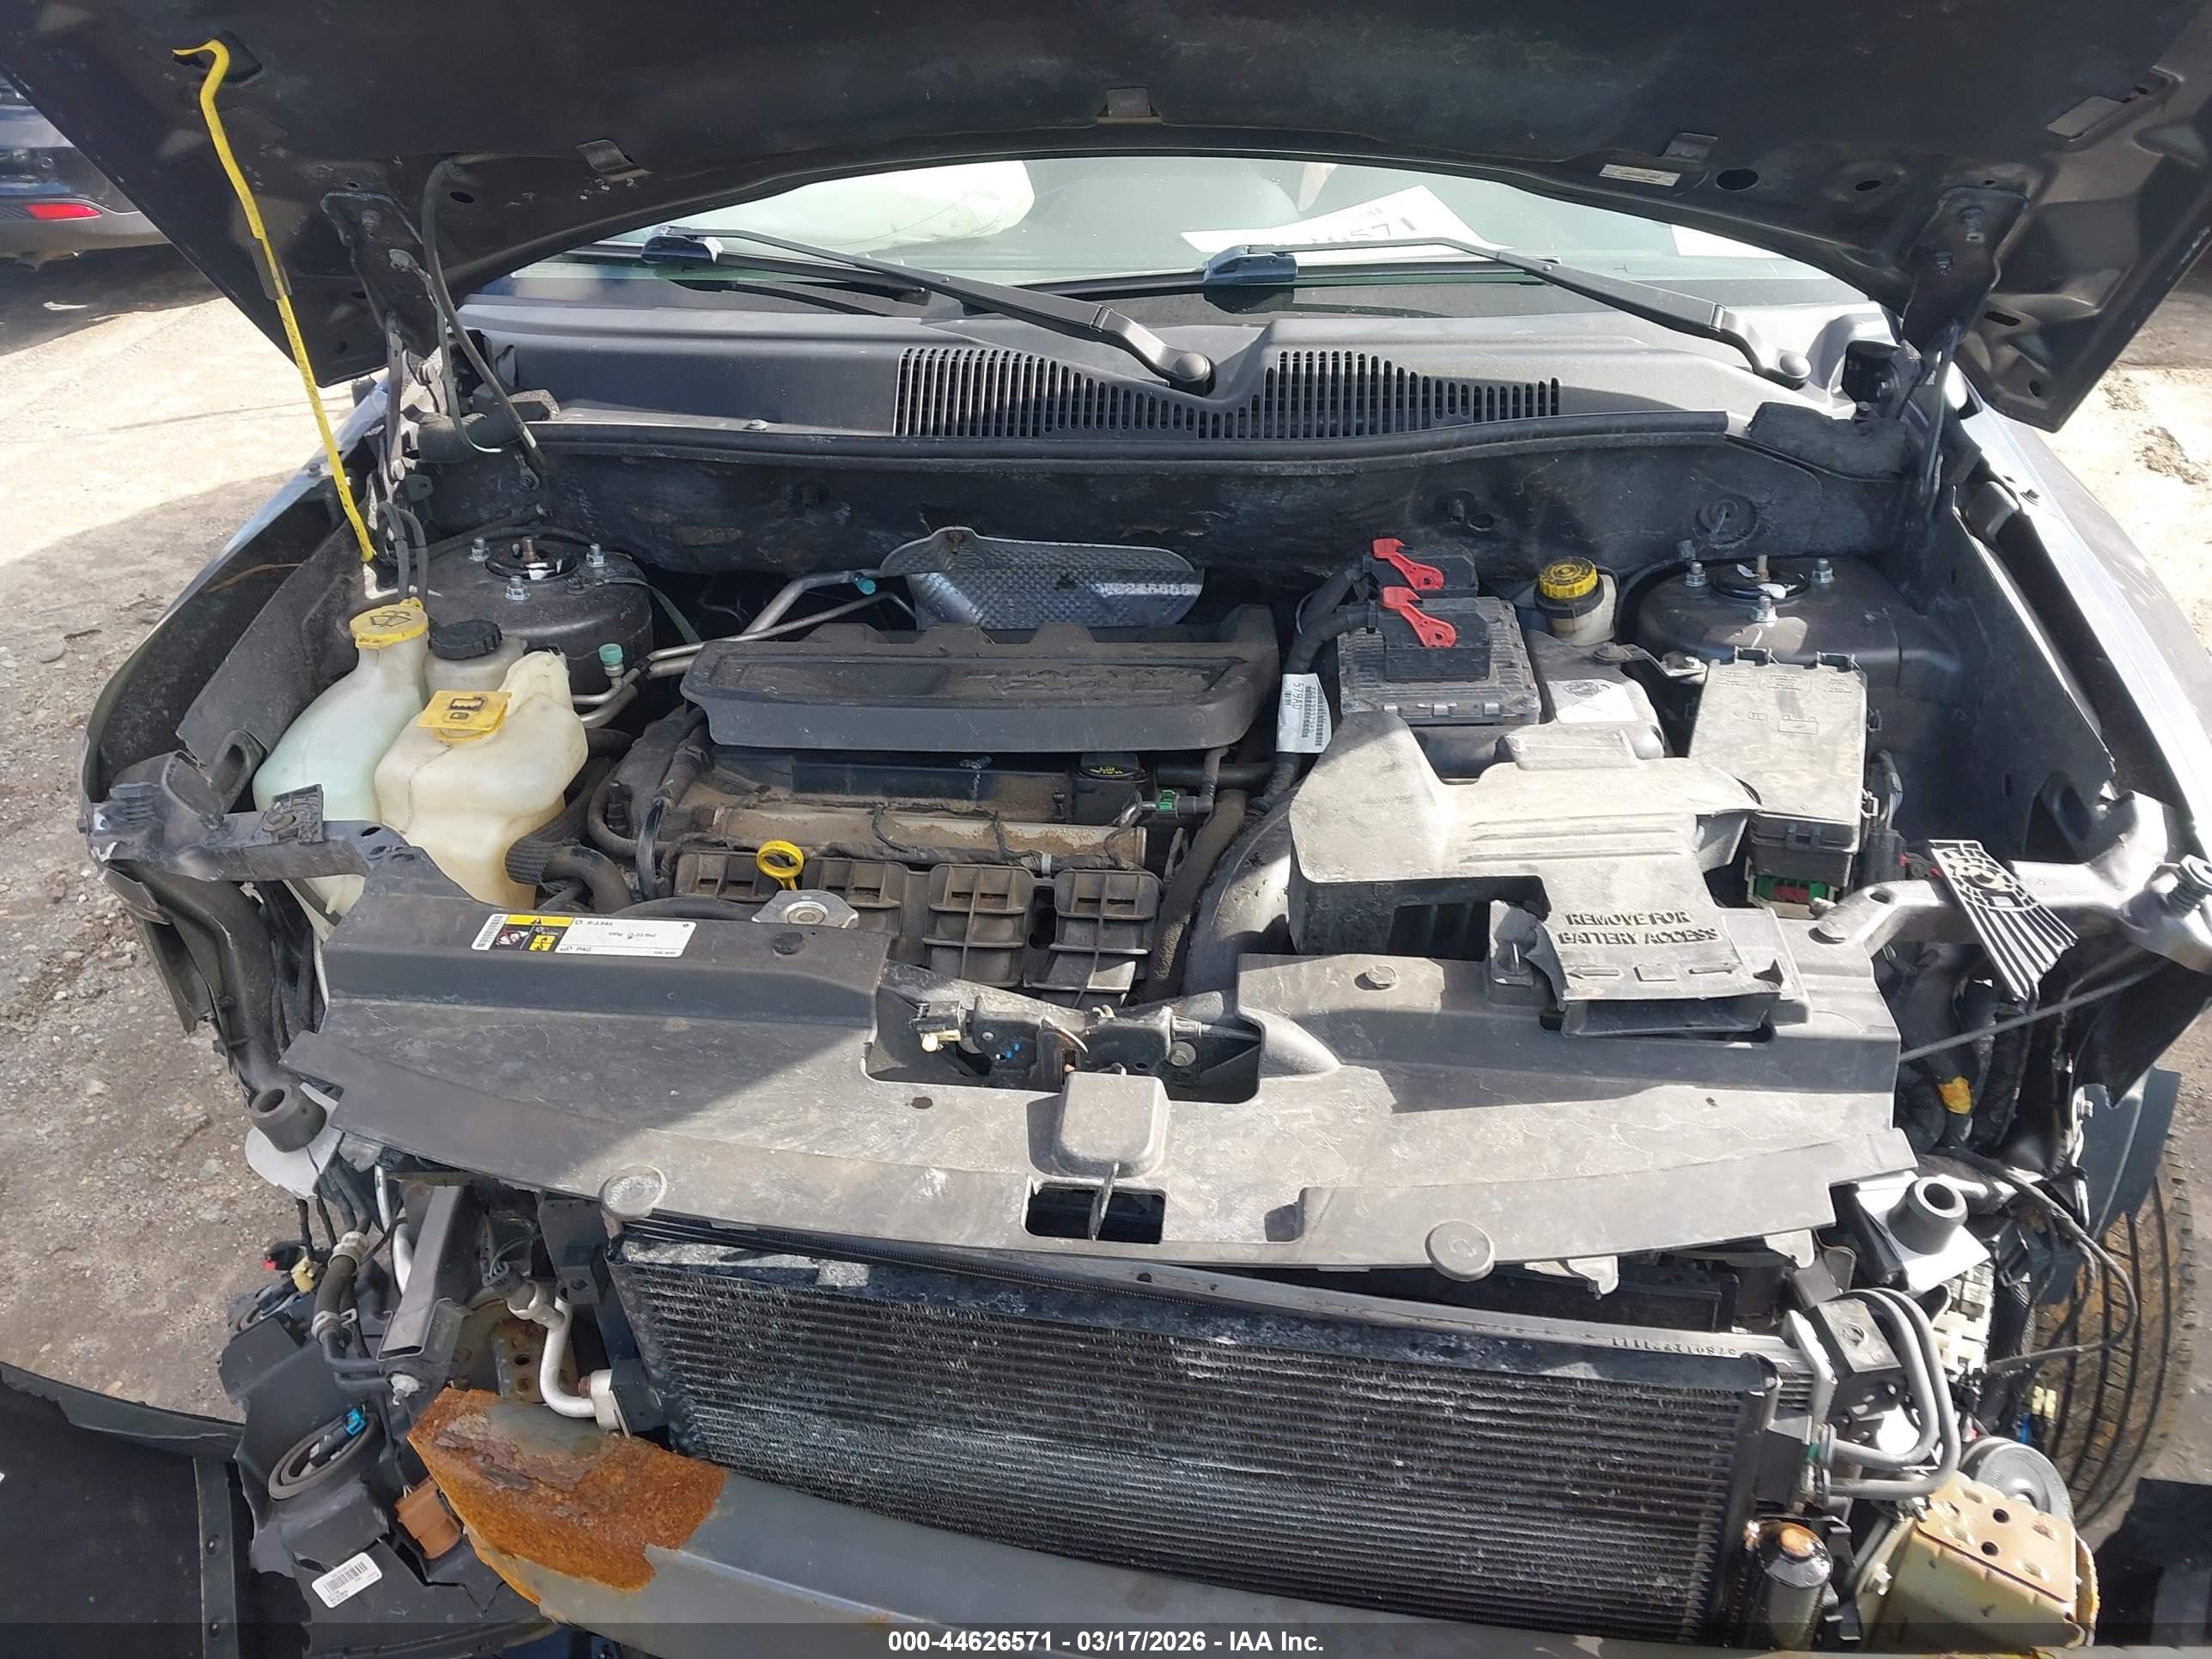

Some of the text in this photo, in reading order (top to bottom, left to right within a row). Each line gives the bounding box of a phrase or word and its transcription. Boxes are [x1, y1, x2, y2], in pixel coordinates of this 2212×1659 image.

[1292, 682, 1304, 711] 579AD
[1565, 910, 1692, 927] REMOVE FOR
[1557, 927, 1720, 945] BATTERY ACCESS
